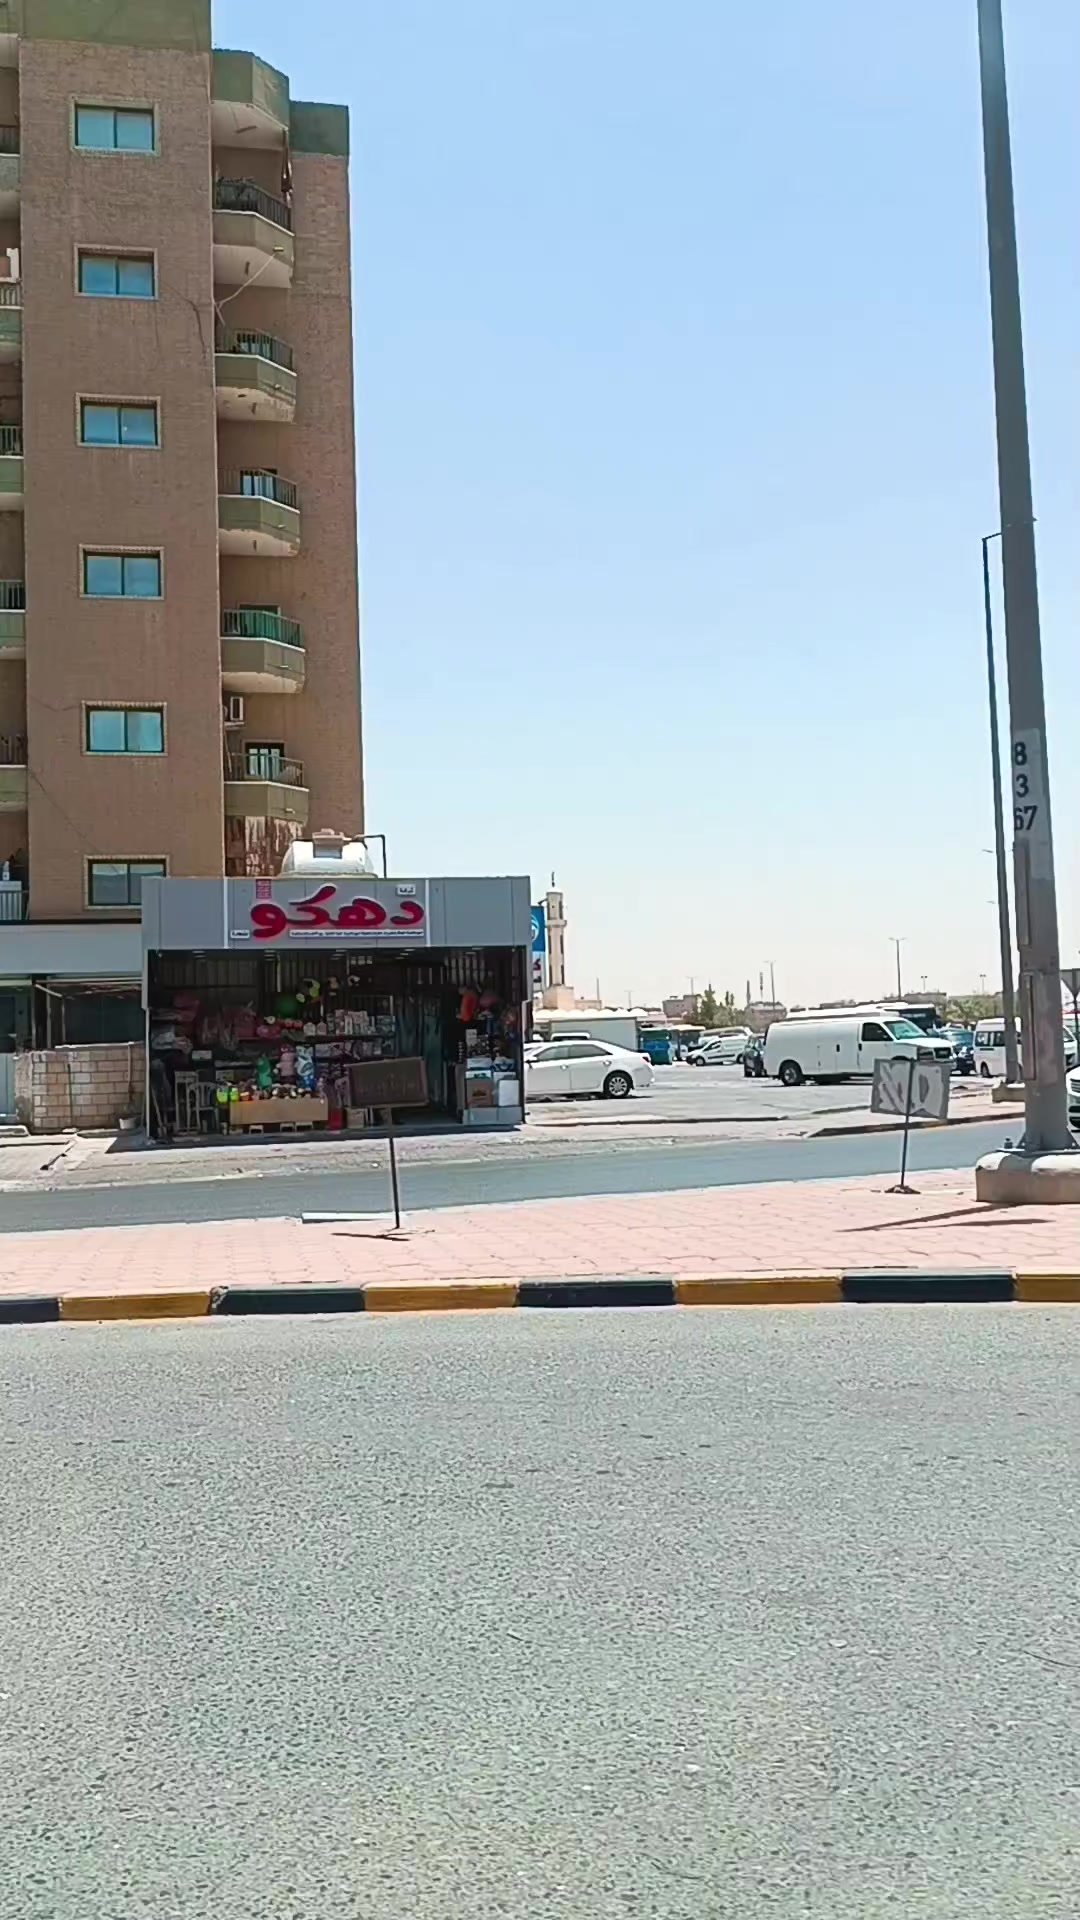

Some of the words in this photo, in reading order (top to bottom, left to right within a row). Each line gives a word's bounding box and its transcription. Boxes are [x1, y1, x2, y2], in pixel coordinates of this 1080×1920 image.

[1014, 742, 1027, 766] 8
[1015, 774, 1029, 798] 3
[250, 883, 425, 939] دهكو
